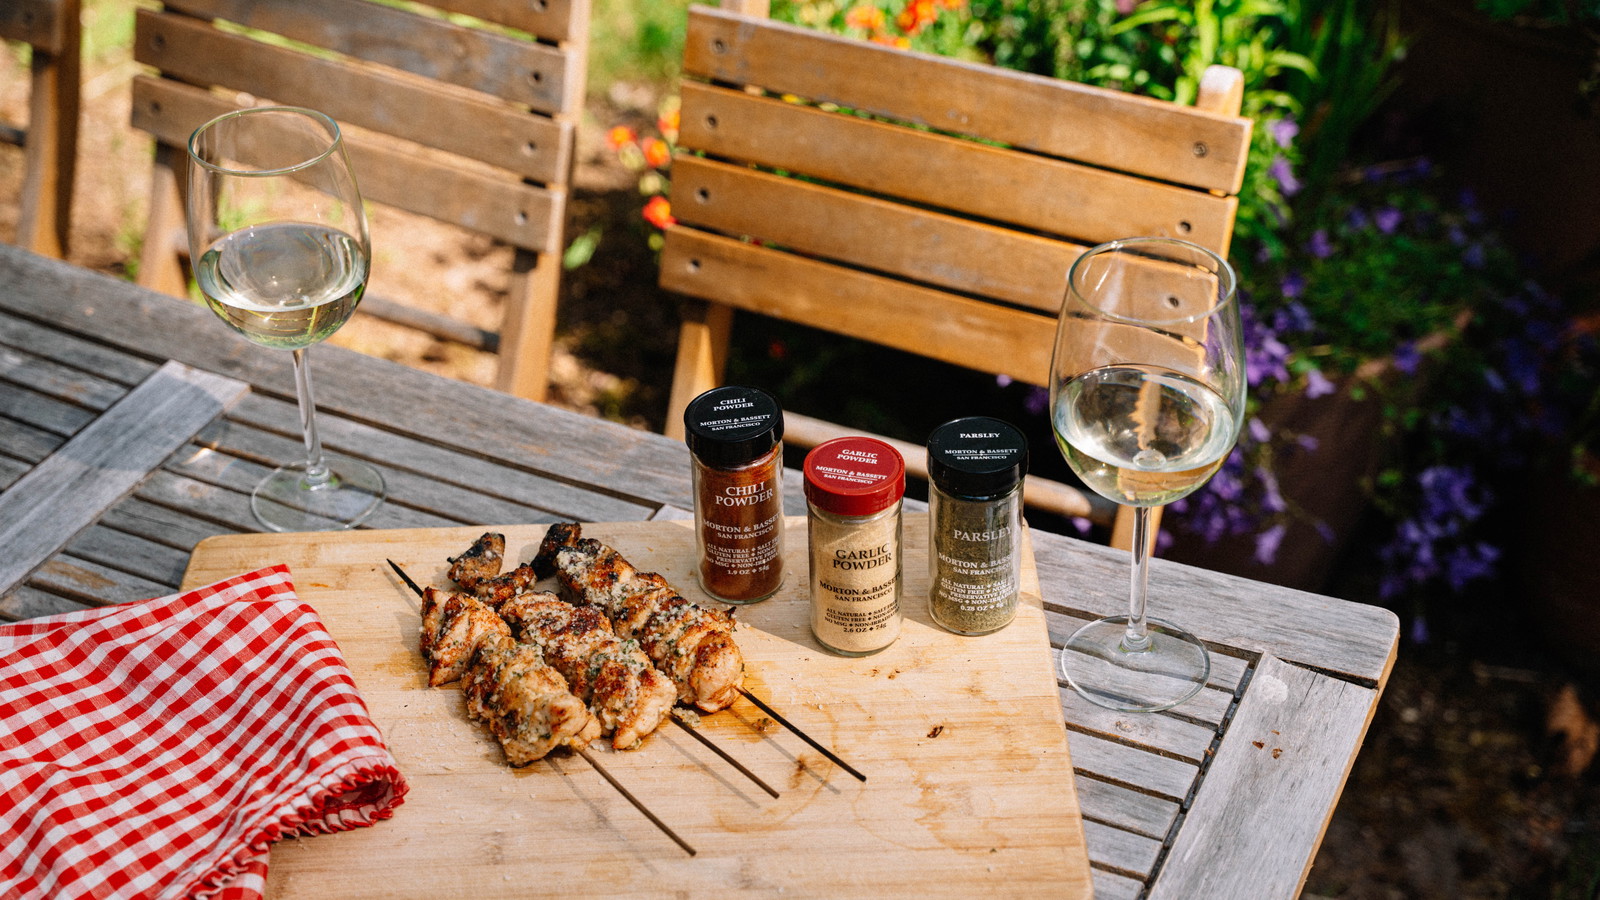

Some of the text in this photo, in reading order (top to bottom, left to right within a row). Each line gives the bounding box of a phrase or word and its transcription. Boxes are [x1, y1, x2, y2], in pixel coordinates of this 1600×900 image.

[714, 403, 754, 411] POWDER
[837, 454, 878, 464] POWDER
[842, 449, 878, 458] GARLIC
[816, 466, 848, 474] MORTON
[838, 476, 873, 484] FRANCISCO
[726, 481, 764, 496] CHILI
[715, 488, 773, 506] POWDER
[703, 519, 741, 533] MORTON
[734, 525, 774, 539] FRANCISCO
[954, 526, 1011, 541] PARSLEY
[707, 548, 731, 557] GLUTEN
[757, 541, 771, 550] SALT
[836, 543, 890, 559] GARLIC
[833, 553, 892, 570] POWDER
[939, 552, 977, 568] MORTON
[820, 580, 859, 595] MORTON
[852, 587, 892, 602] FRANCISCO
[941, 582, 966, 593] GLUTEN
[826, 613, 849, 621] GLUTEN
